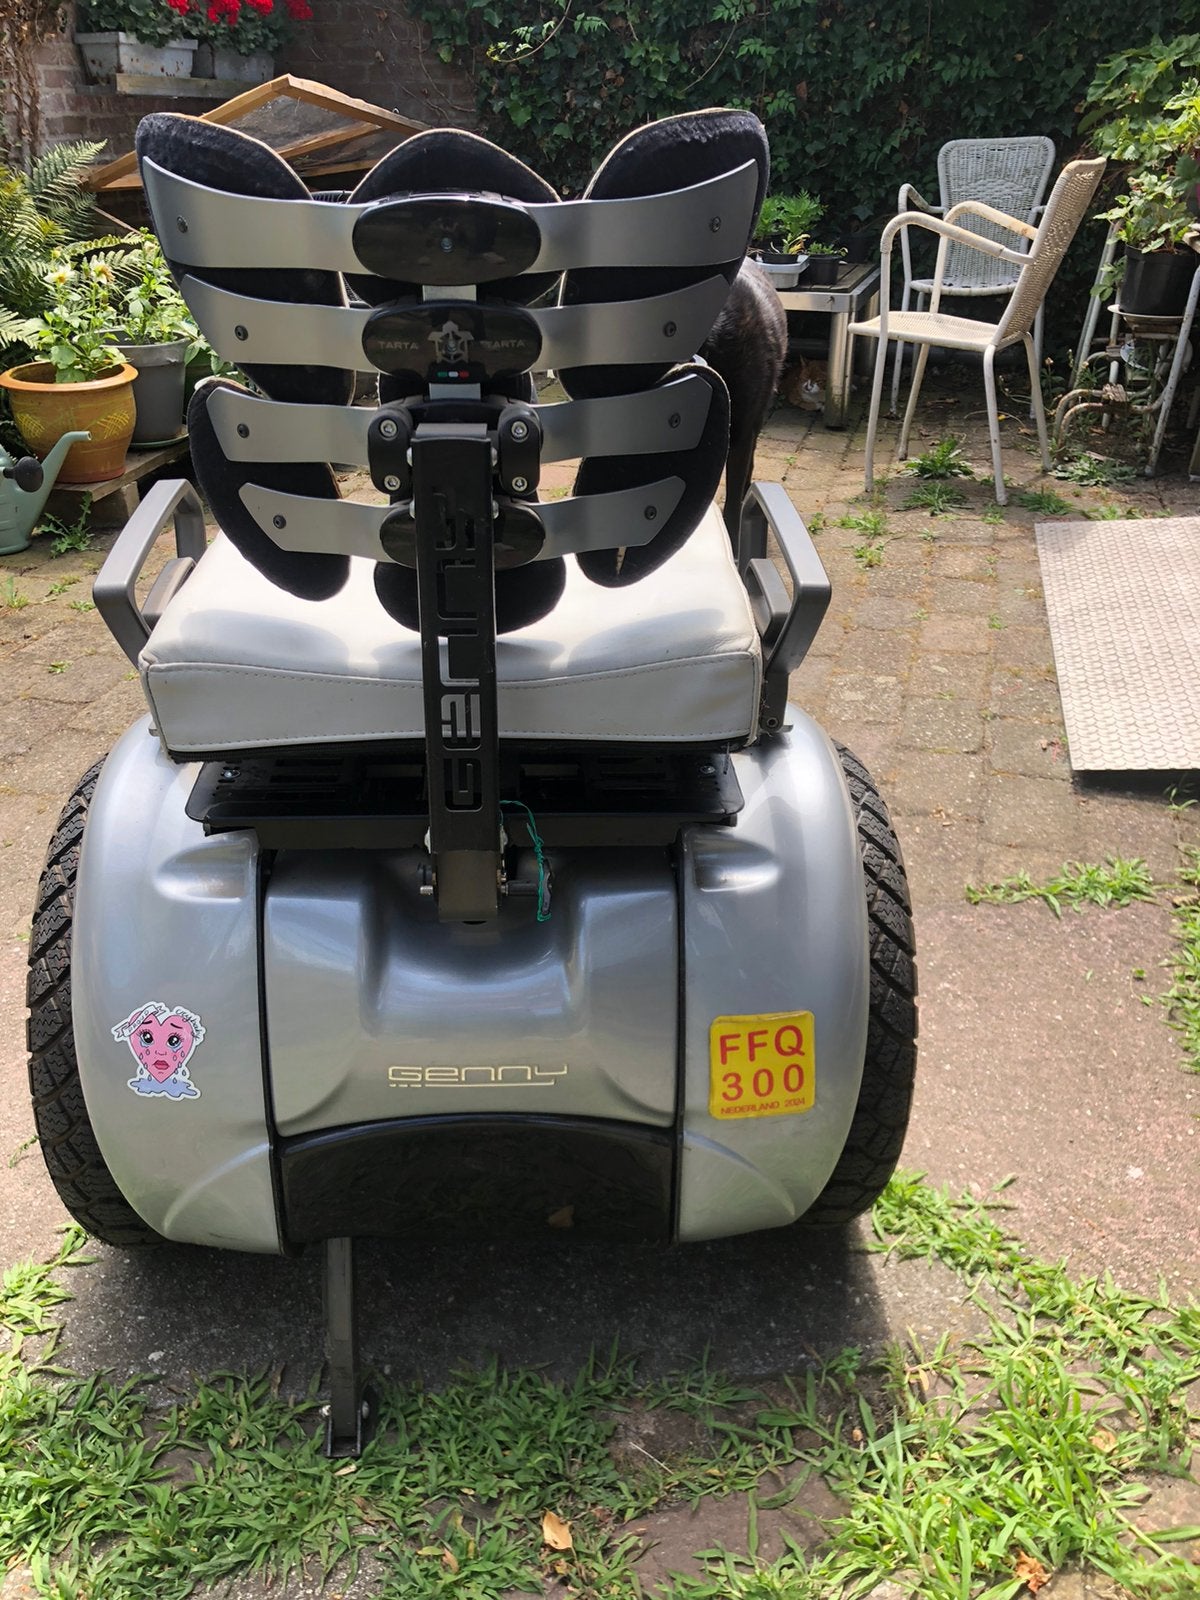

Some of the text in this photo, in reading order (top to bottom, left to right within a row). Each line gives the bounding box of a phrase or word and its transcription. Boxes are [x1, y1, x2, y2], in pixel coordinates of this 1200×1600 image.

[378, 340, 420, 350] TARTA
[719, 1024, 806, 1065] FFQ
[388, 1063, 568, 1087] Genny
[721, 1063, 805, 1101] 300
[720, 1097, 806, 1115] NEDERLAND 2024
